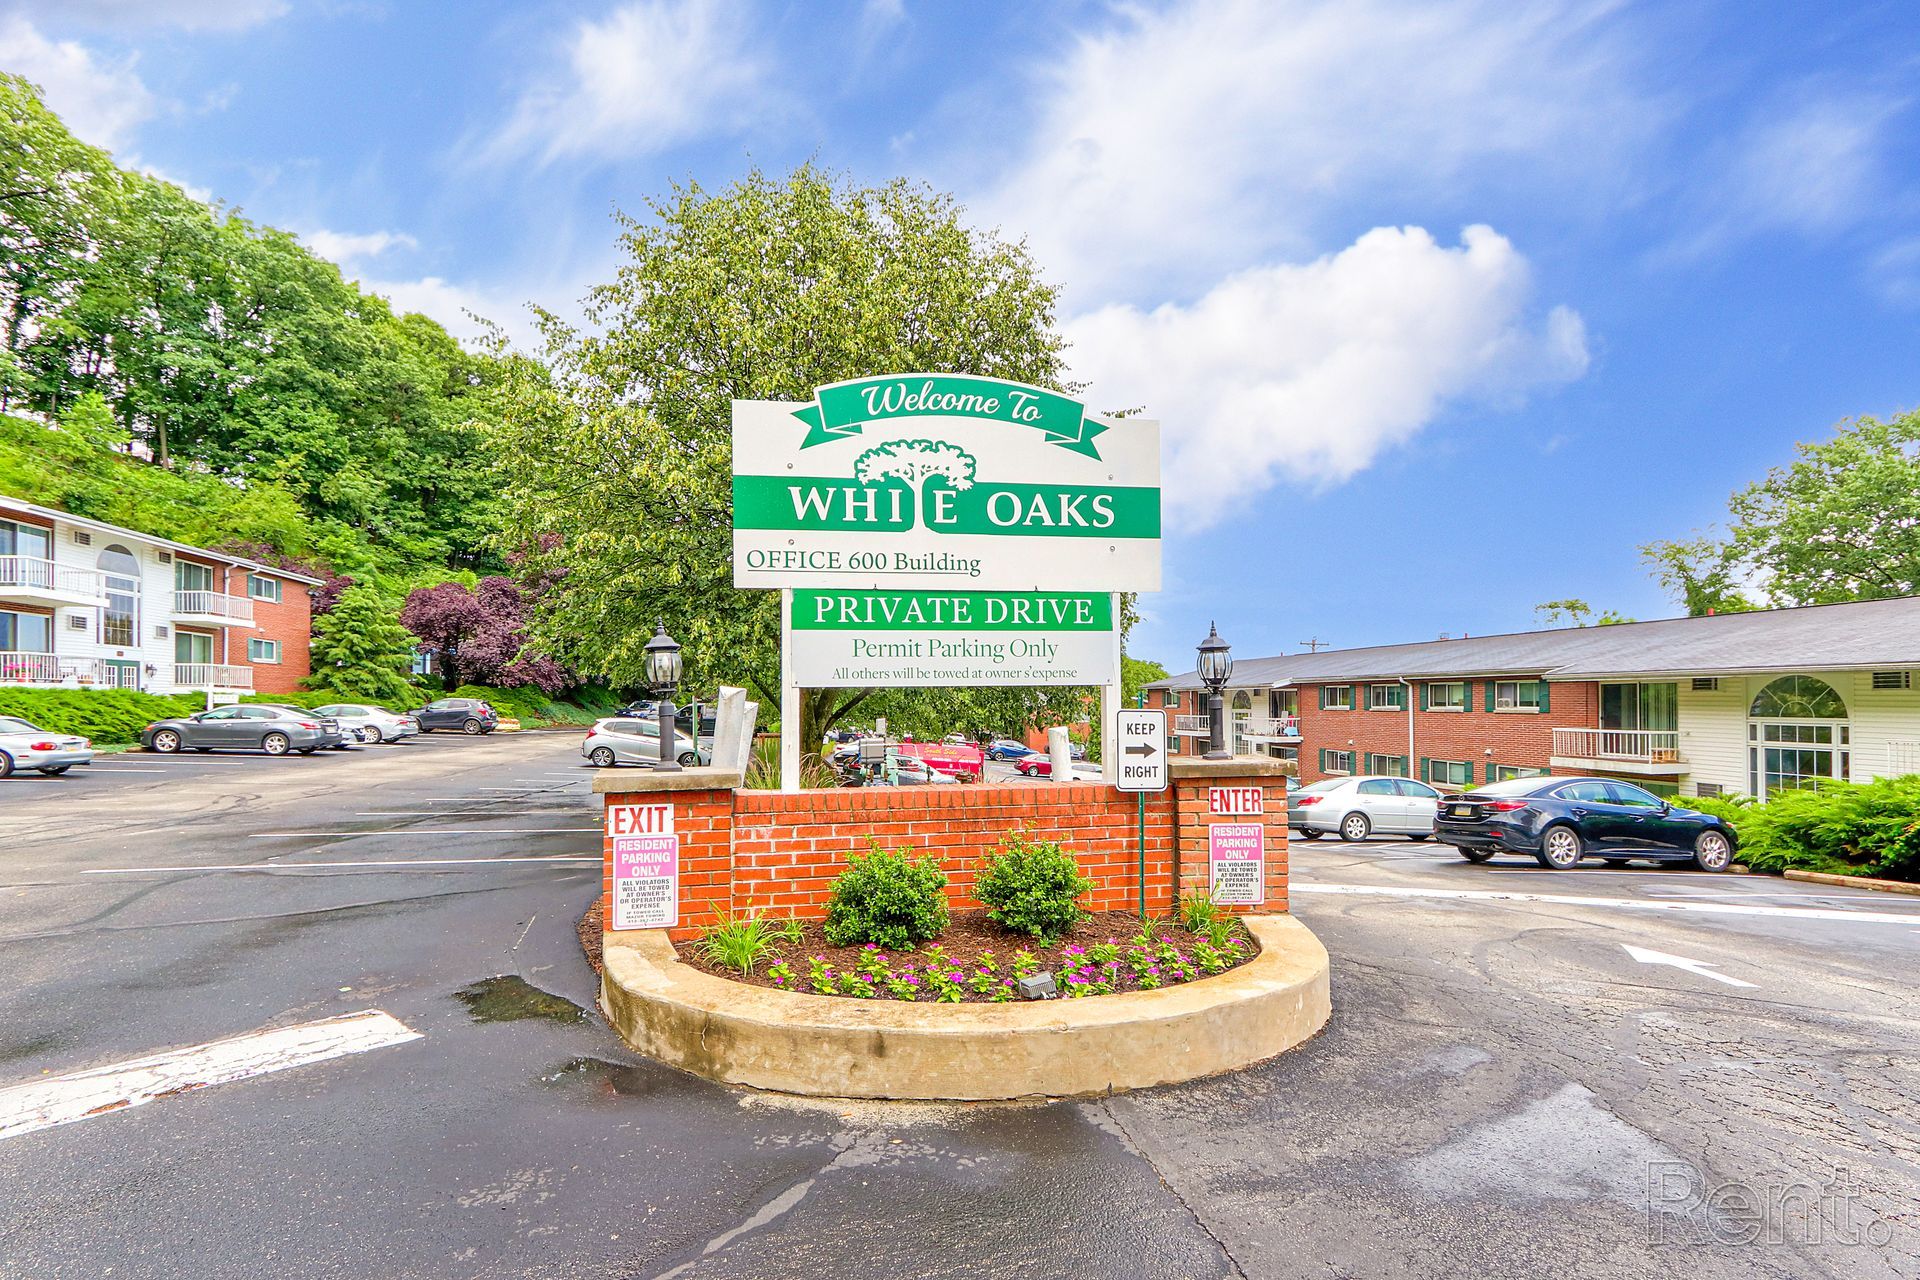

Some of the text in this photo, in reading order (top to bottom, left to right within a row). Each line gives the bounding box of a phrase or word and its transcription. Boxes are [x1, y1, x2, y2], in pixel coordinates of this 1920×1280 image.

[861, 380, 1042, 422] Welcome To
[986, 491, 1115, 528] OAKS
[746, 550, 981, 577] OFFICE 600 Building
[814, 596, 1095, 625] PRIVATE DRIVE
[851, 638, 1059, 664] Permit Parking Only
[832, 668, 849, 680] All
[851, 667, 890, 680] others
[892, 667, 914, 679] will
[916, 667, 931, 679] be
[933, 667, 969, 679] towed
[972, 668, 982, 679] at
[1127, 723, 1156, 735] KEEP
[1125, 766, 1158, 778] RIGHT
[1210, 789, 1262, 812] ENTER
[614, 806, 668, 834] EXIT
[1213, 826, 1260, 837] RESIDENT
[618, 839, 674, 852] RESIDENT
[1216, 838, 1257, 848] PARKING
[621, 851, 671, 865] PARKING
[1225, 849, 1249, 860] ONLY
[631, 865, 661, 877] ONLY
[635, 878, 670, 886] VIOLATORS
